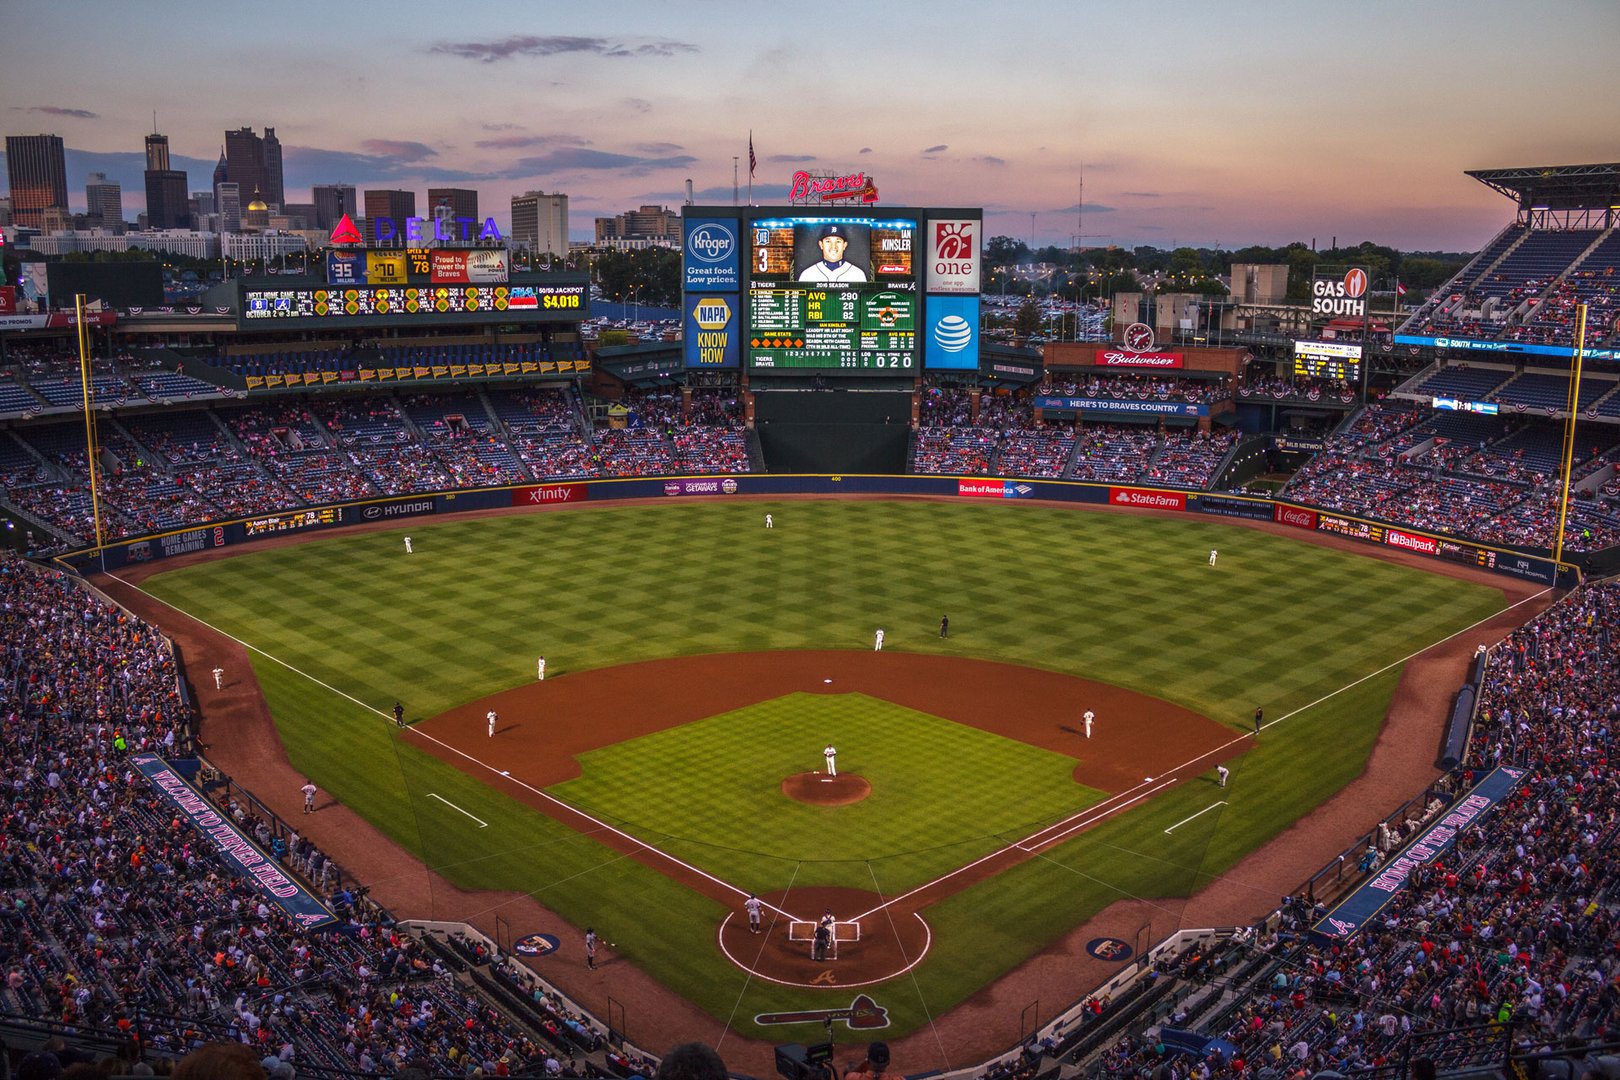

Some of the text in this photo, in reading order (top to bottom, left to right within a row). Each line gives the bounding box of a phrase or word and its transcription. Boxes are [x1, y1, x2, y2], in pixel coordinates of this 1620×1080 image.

[790, 170, 864, 202] Braves
[375, 217, 502, 240] DELTA
[902, 230, 911, 238] IAN
[694, 231, 730, 256] Kroger
[882, 239, 911, 250] KINSLER
[413, 262, 430, 273] 78
[758, 248, 768, 272] 3
[936, 263, 972, 275] one
[707, 276, 737, 284] prices.
[264, 291, 278, 299] HOME
[280, 290, 295, 298] GAME
[1314, 281, 1344, 297] GAS
[544, 295, 579, 308] $4,018
[1312, 298, 1364, 316] SOUTH
[700, 307, 726, 322] NAPA
[842, 312, 854, 320] 82
[697, 332, 728, 348] KNOW
[1450, 340, 1470, 348] SOUTH
[700, 348, 724, 363] HOW
[1104, 353, 1174, 365] Budweiser
[1574, 348, 1592, 356] EERY
[876, 356, 912, 368] 0 2 0
[1070, 400, 1097, 408] HERE'S
[1110, 402, 1140, 410] BRAVES
[1141, 403, 1179, 412] COUNTRY
[530, 486, 572, 502] xfinity
[960, 484, 1014, 494] Bank of America
[384, 502, 433, 515] HYUNDAI
[1284, 510, 1311, 526] Coca-Cola
[1360, 524, 1368, 532] 78
[161, 530, 207, 546] HOME GAMES
[214, 526, 224, 546] 2
[1400, 535, 1434, 552] Ballpark
[165, 540, 205, 556] REMAINING
[1442, 542, 1460, 551] Kinsler
[1499, 564, 1548, 580] NORTHSIDE HOSPITAL
[151, 770, 298, 898] WELCOME TO TURNER FIELD
[1370, 794, 1490, 892] HOME OF THE BRAVES
